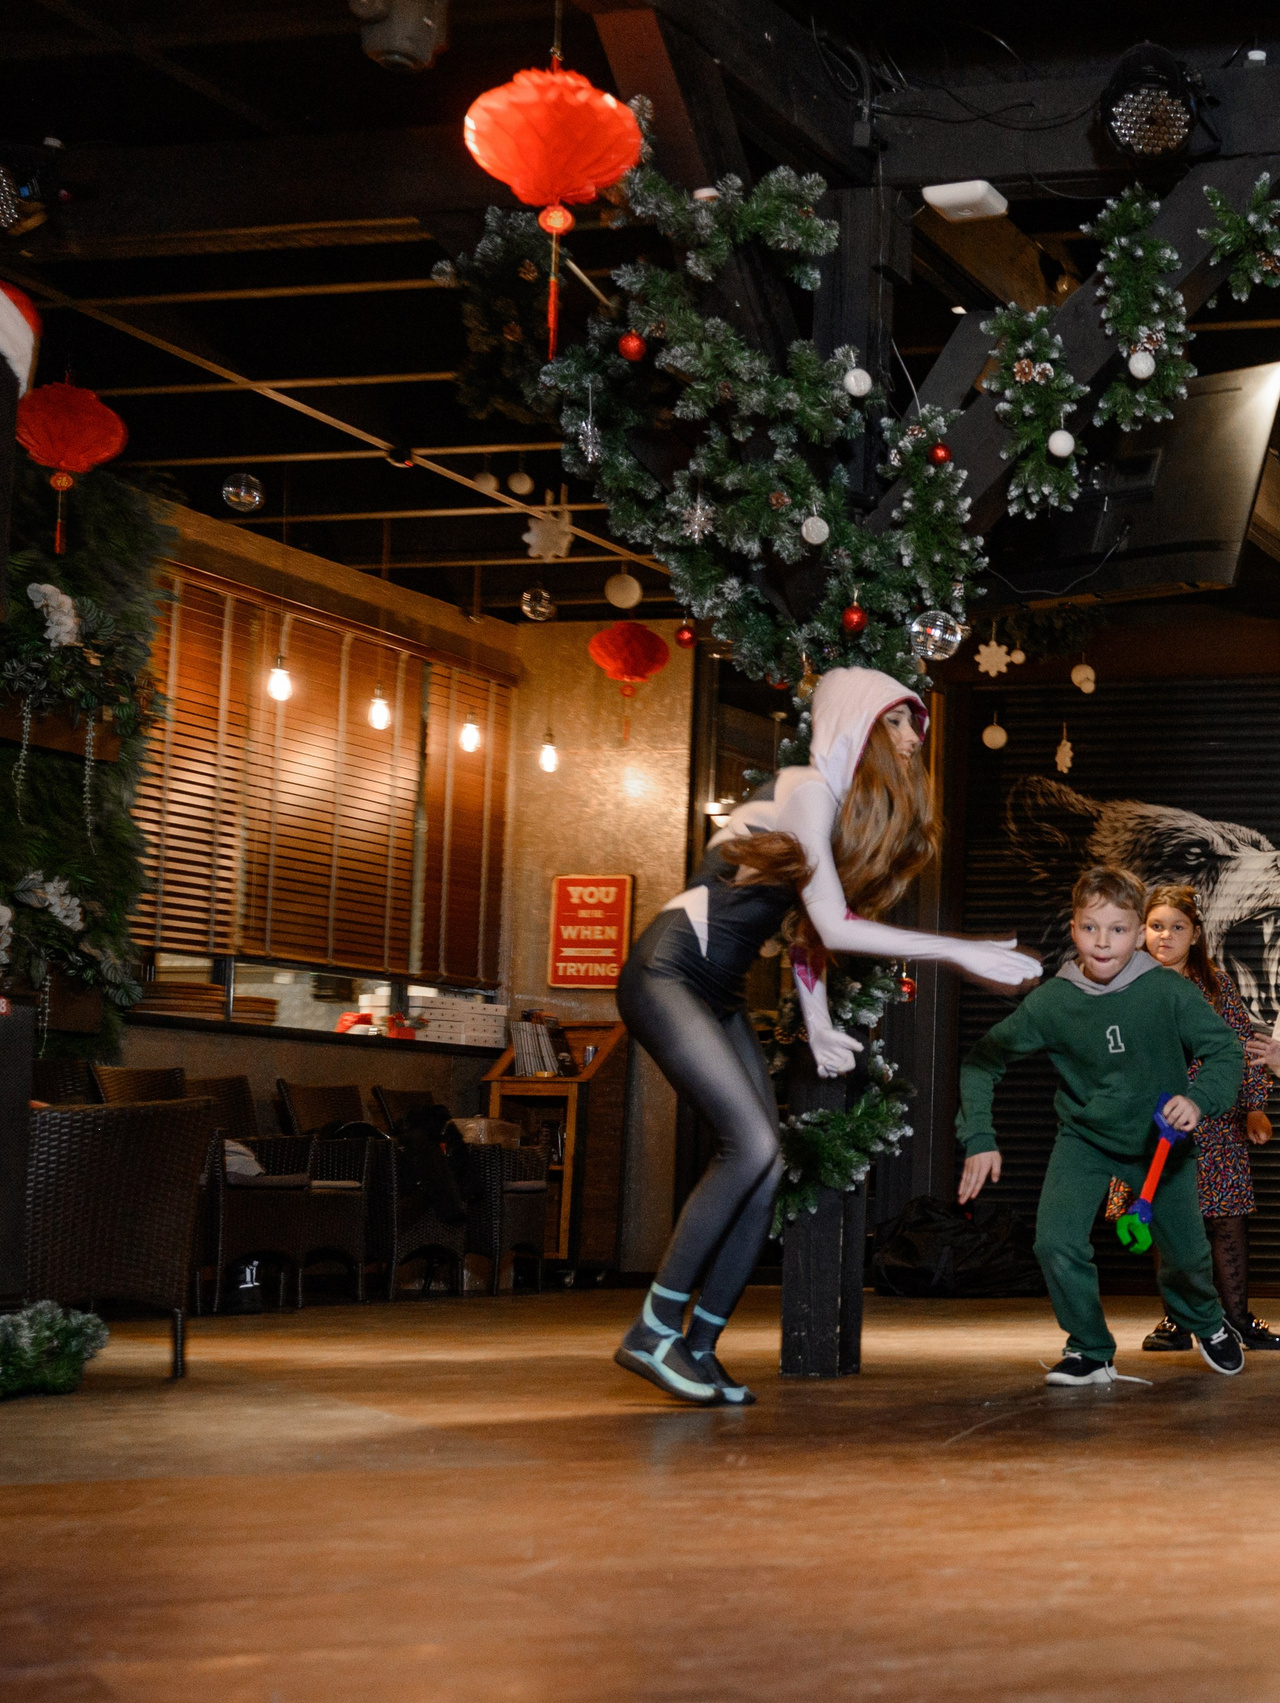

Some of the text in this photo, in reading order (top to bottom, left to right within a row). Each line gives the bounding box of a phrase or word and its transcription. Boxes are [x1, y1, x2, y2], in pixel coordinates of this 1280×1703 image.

[566, 886, 618, 904] YOU
[560, 925, 618, 940] WHEN
[556, 962, 619, 977] TRYING
[1106, 1025, 1125, 1053] 1
